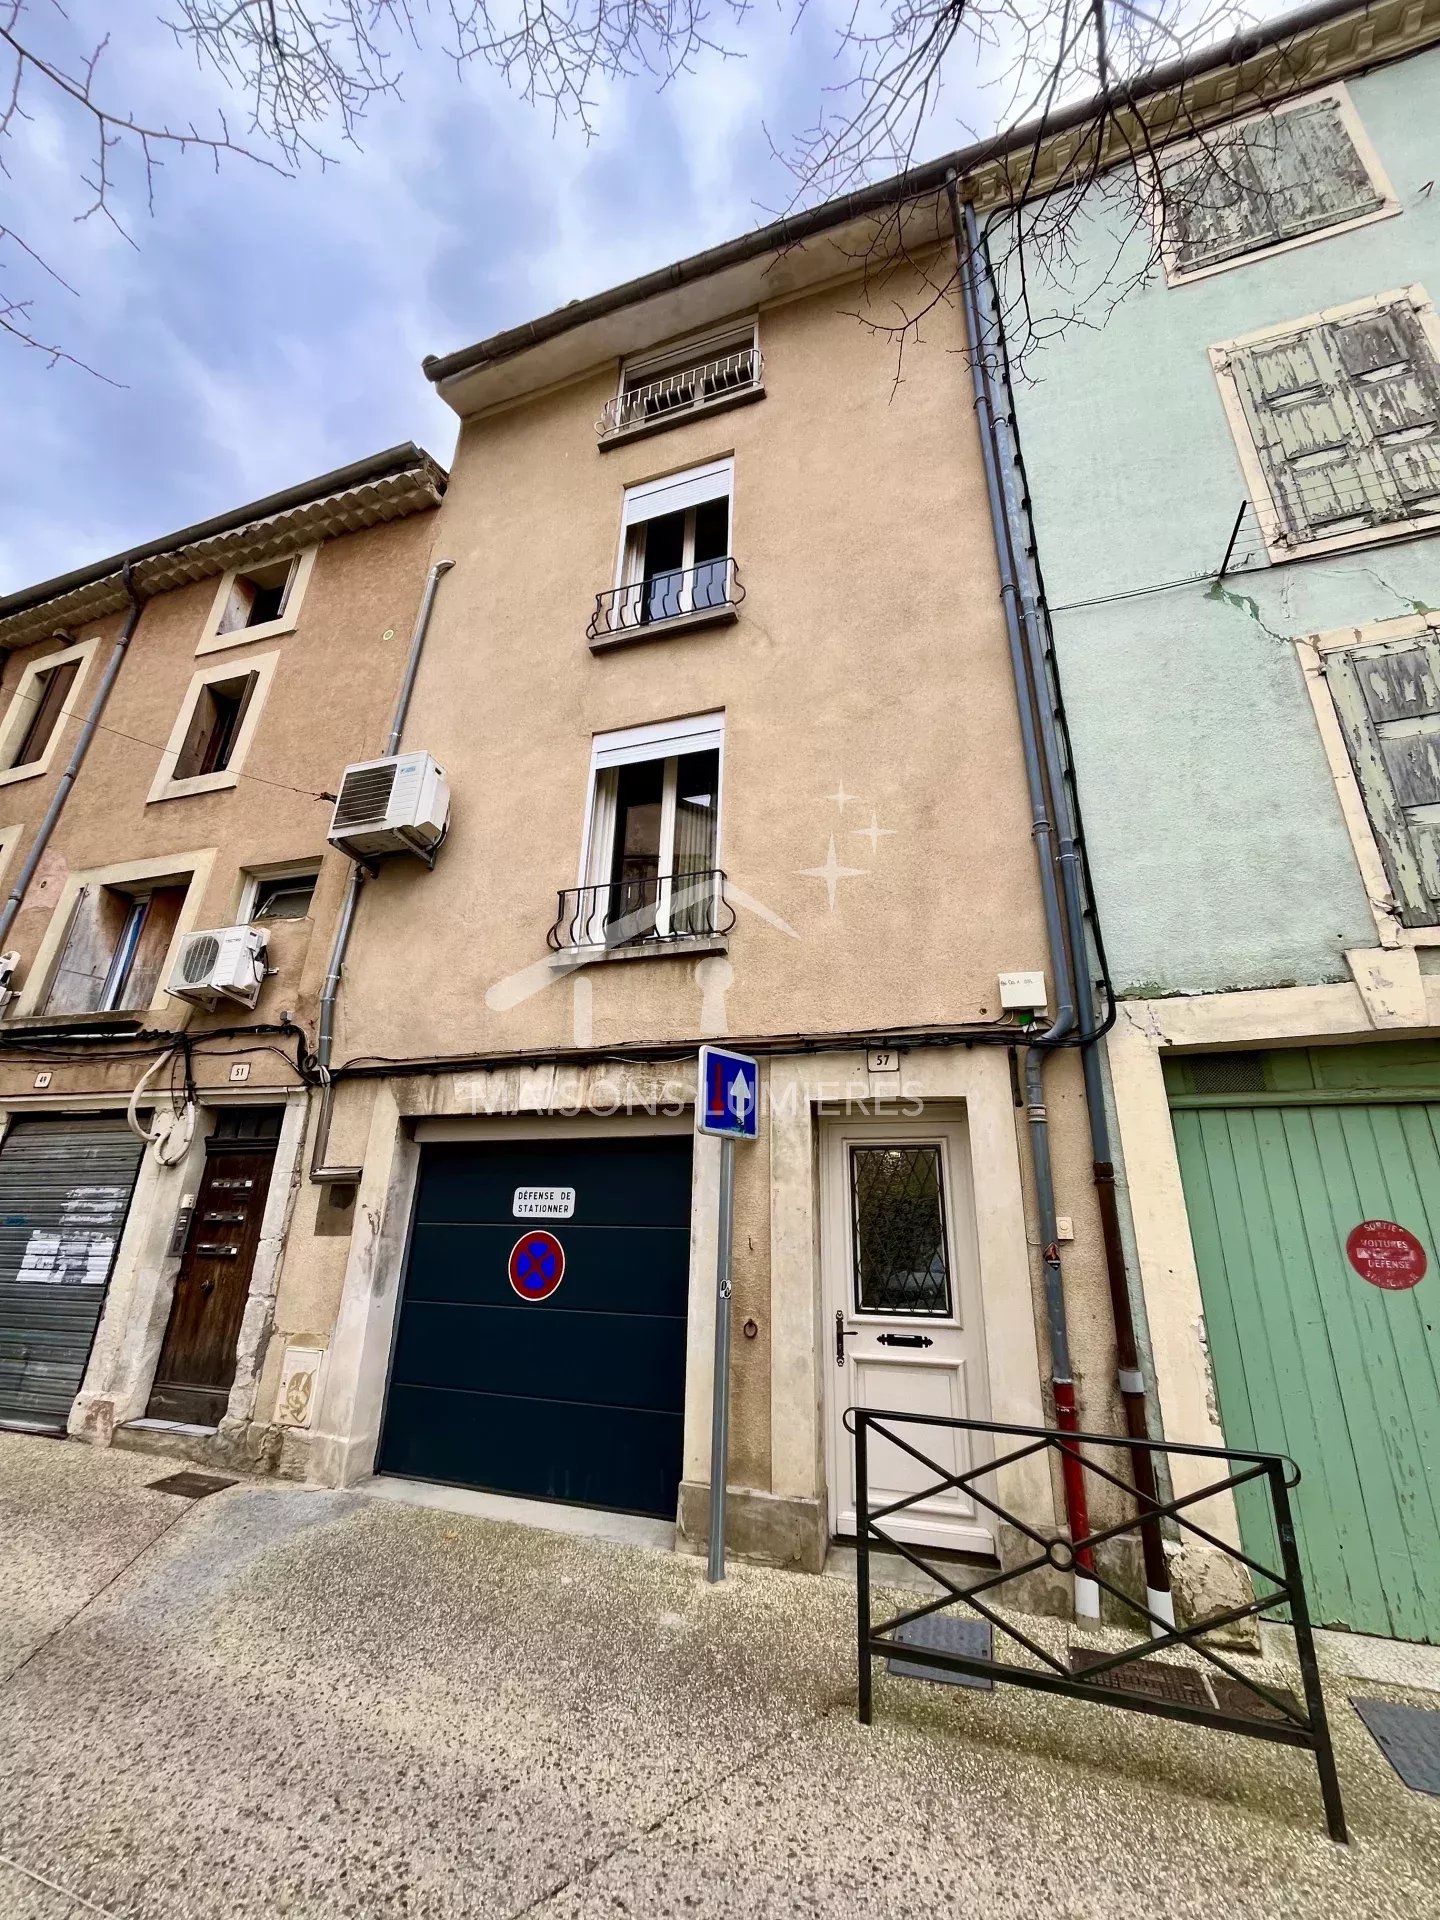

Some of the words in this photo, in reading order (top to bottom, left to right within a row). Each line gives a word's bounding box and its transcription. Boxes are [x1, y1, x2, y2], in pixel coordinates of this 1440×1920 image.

[876, 1054, 890, 1066] 57
[235, 1067, 244, 1077] 51
[517, 1190, 555, 1201] DÉFENSE
[560, 1191, 572, 1201] DE
[517, 1204, 570, 1214] STATIONNER
[1363, 1222, 1397, 1232] SORTIE
[1360, 1239, 1408, 1249] VOITURES
